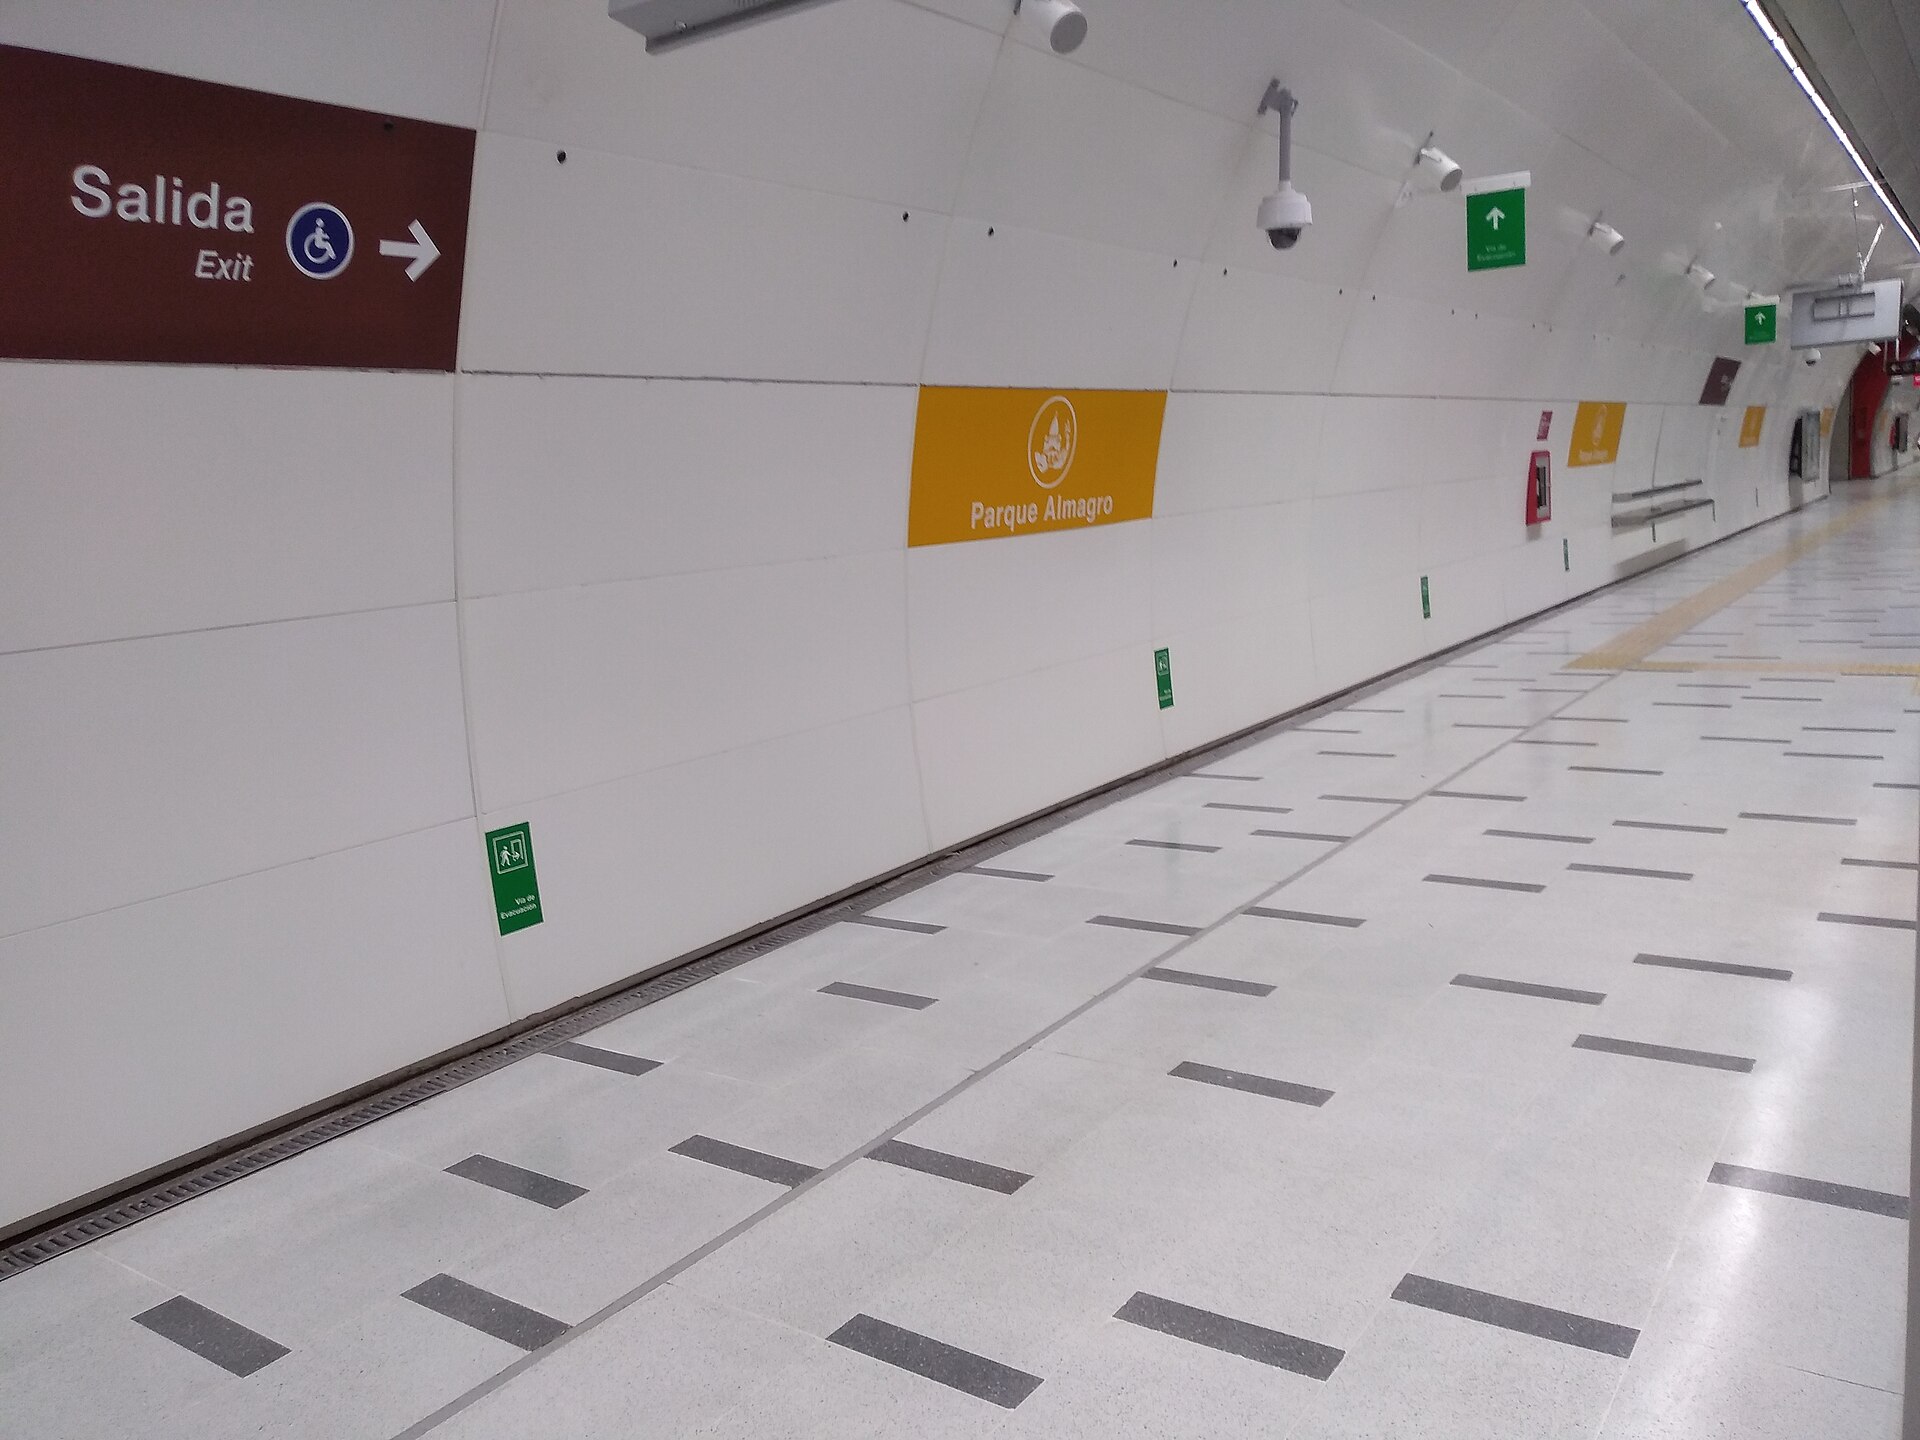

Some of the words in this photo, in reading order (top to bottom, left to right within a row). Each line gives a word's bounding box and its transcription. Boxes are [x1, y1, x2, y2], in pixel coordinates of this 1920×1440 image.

[71, 164, 255, 234] Salida
[195, 250, 255, 282] Exit
[971, 501, 1039, 532] Parque
[1043, 495, 1113, 523] Almagro
